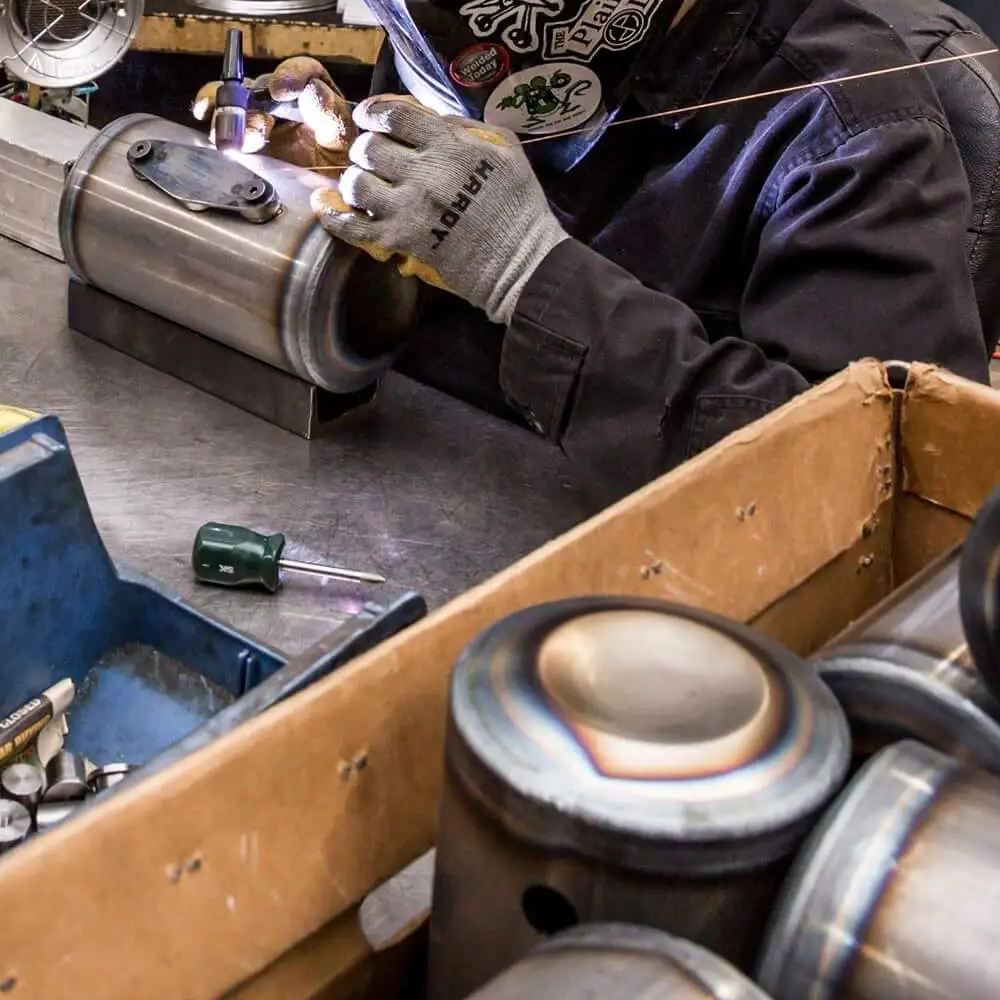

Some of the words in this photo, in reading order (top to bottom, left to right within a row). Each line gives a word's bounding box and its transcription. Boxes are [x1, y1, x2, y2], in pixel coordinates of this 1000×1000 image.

[554, 30, 565, 49] THE
[461, 47, 498, 76] Welded
[467, 59, 498, 81] Today
[431, 159, 495, 242] HARDY
